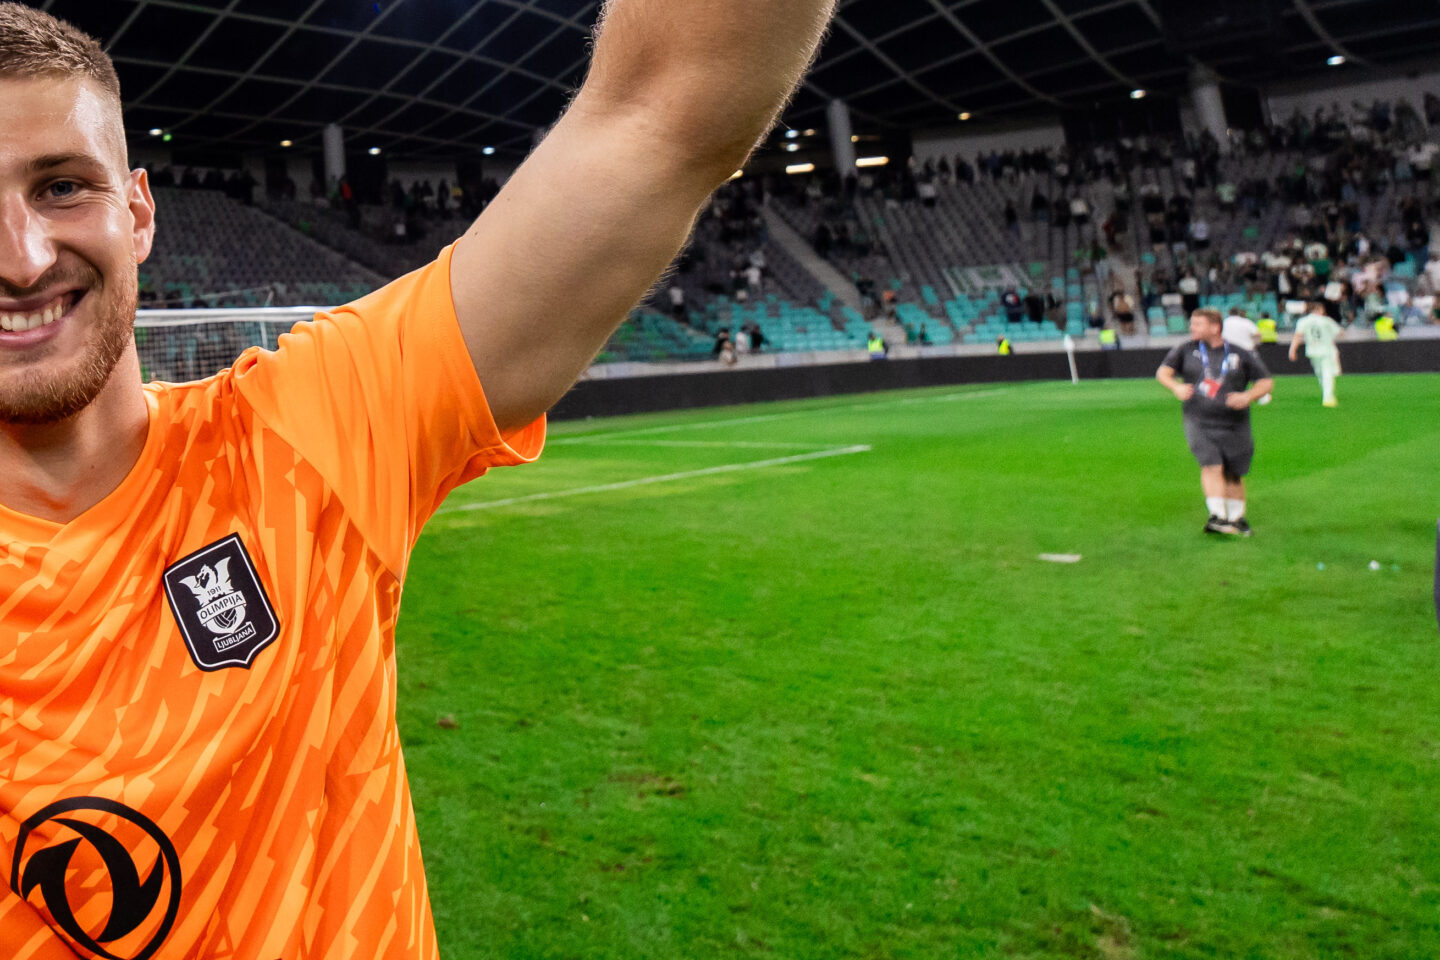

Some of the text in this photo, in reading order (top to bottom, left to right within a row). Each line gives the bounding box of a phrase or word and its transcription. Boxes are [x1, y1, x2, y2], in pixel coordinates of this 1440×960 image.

[207, 586, 221, 596] 1911
[200, 593, 243, 620] OLIMPIJA
[217, 627, 253, 649] LJUBLJANA
